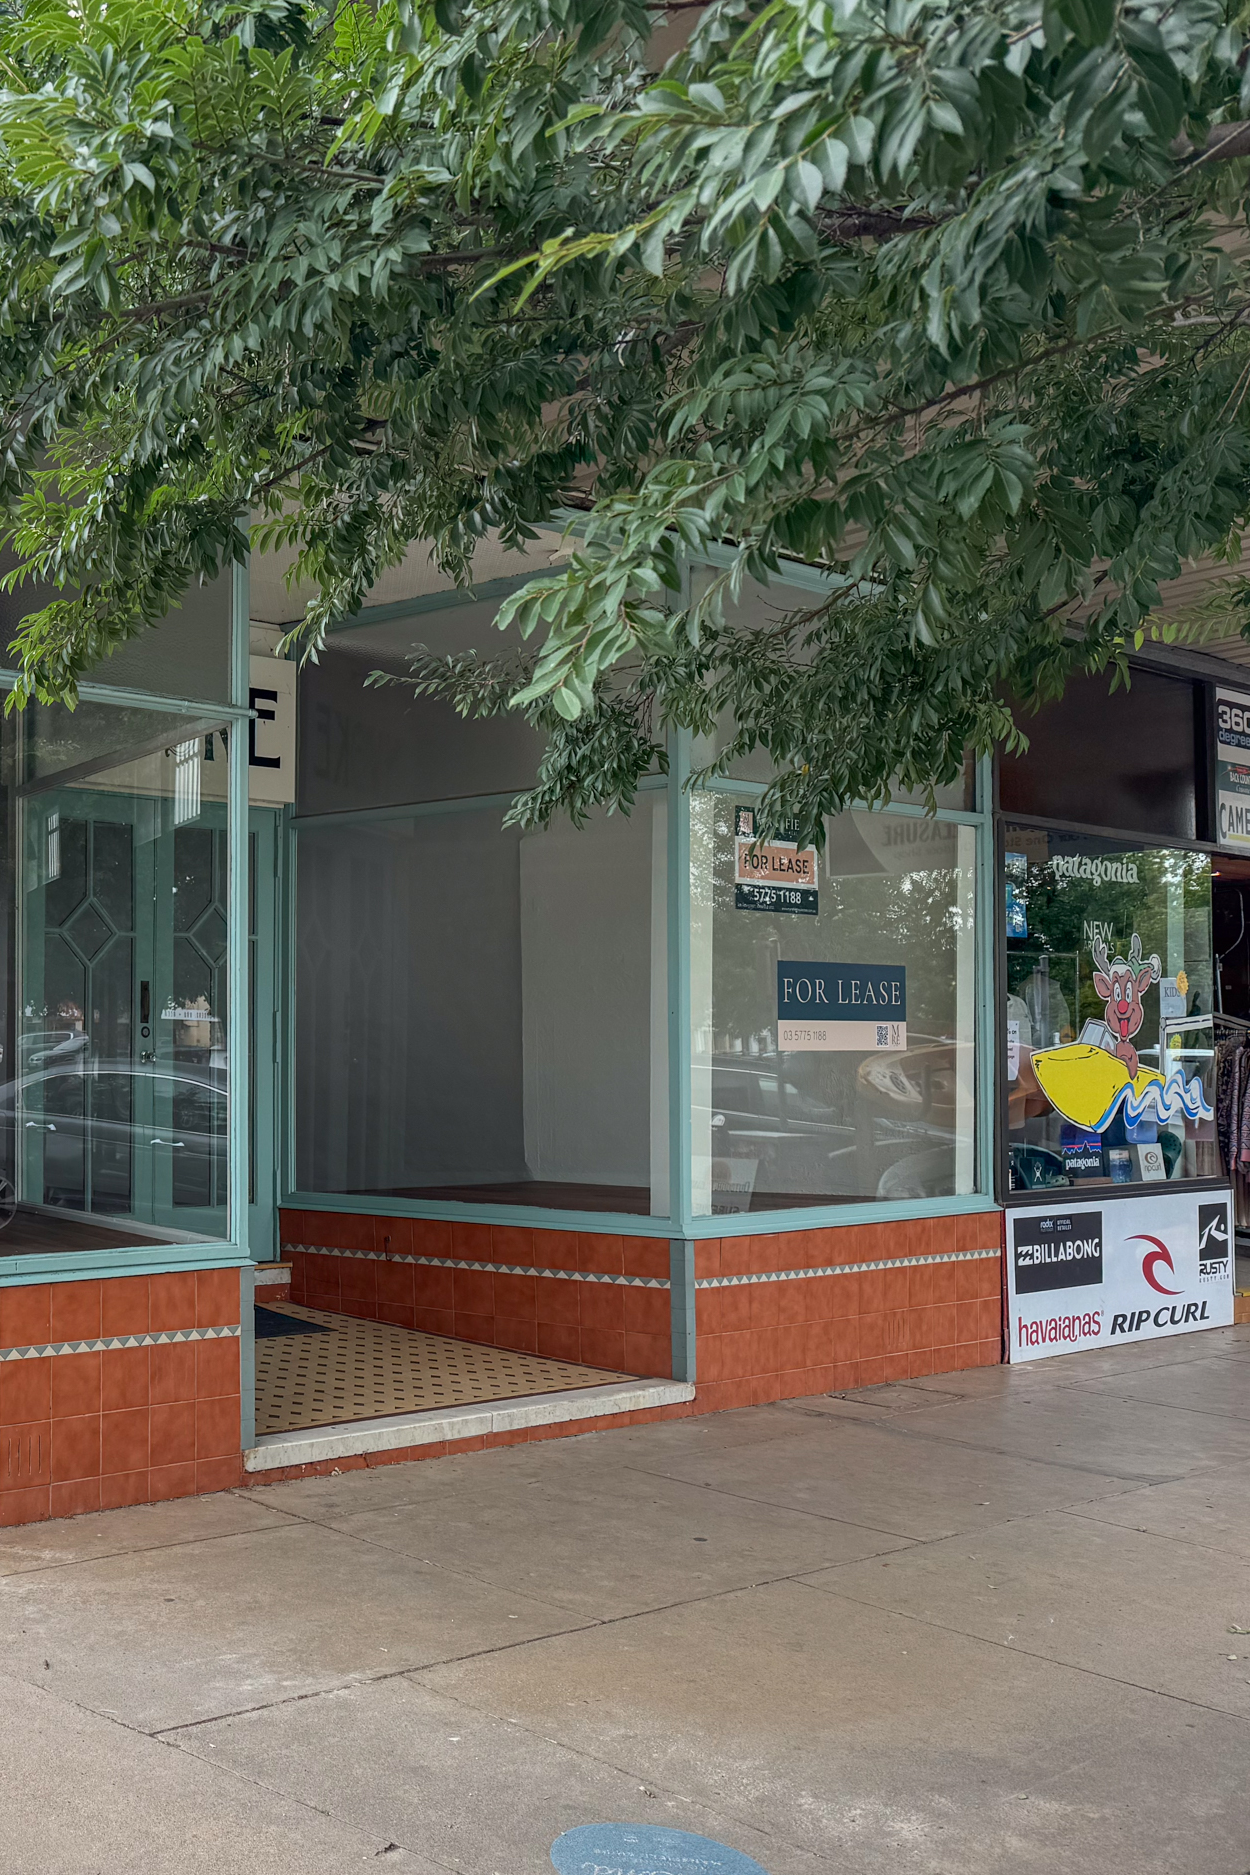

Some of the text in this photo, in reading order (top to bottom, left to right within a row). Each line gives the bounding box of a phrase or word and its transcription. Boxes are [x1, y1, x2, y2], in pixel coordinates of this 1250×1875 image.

[744, 853, 809, 875] FOR LEASE
[1052, 853, 1140, 886] patagonia
[754, 888, 801, 904] 5775 1188
[1084, 920, 1113, 941] NEW
[783, 978, 901, 1006] FOR LEASE
[783, 1030, 827, 1041] 03 5775 1188
[1065, 1156, 1100, 1171] patagonia
[1034, 1238, 1100, 1265] BILLABONG
[1199, 1260, 1229, 1277] RUSTY
[1018, 1310, 1101, 1347] havaianas
[1110, 1300, 1210, 1336] RIP CURL
